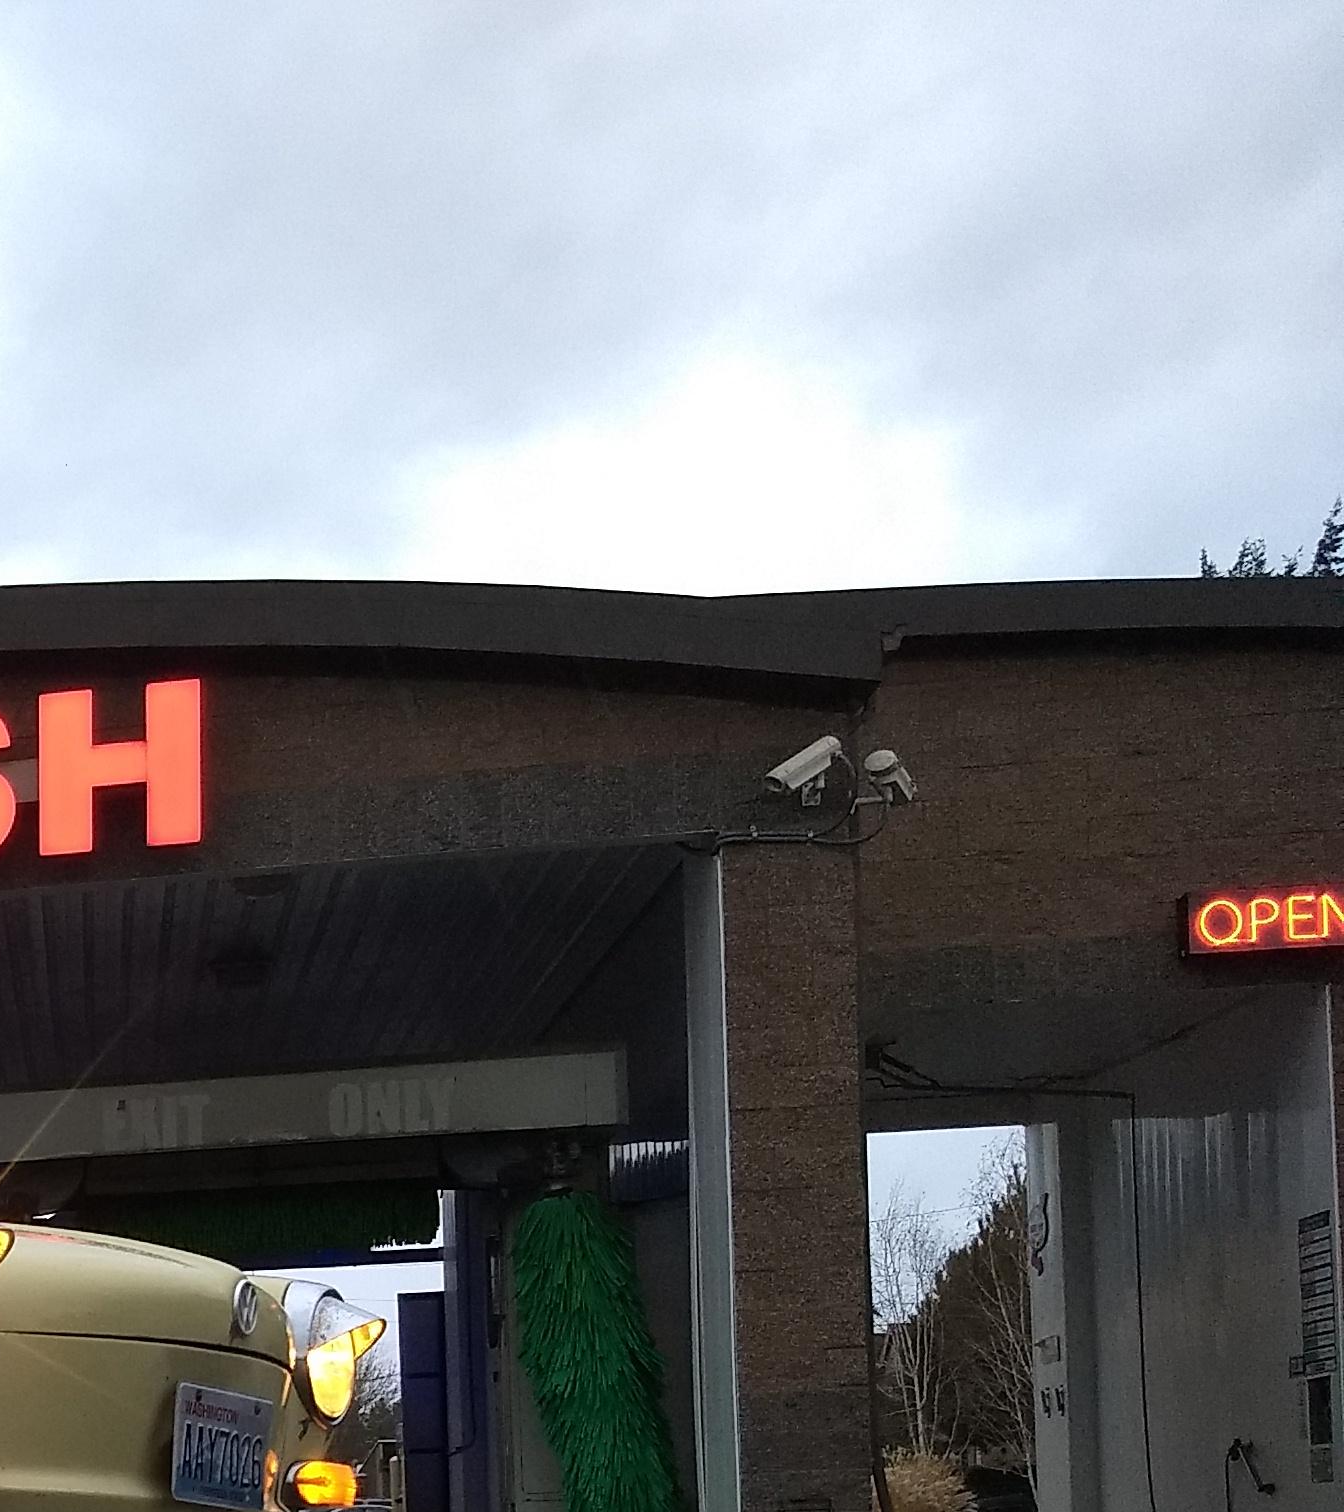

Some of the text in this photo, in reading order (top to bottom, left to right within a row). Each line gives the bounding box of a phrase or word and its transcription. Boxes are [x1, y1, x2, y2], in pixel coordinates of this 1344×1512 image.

[1199, 893, 1344, 945] OPEN
[102, 1079, 452, 1151] EXIT ONLY
[185, 1400, 239, 1424] WASHINGTON
[180, 1420, 263, 1489] AAY7026
